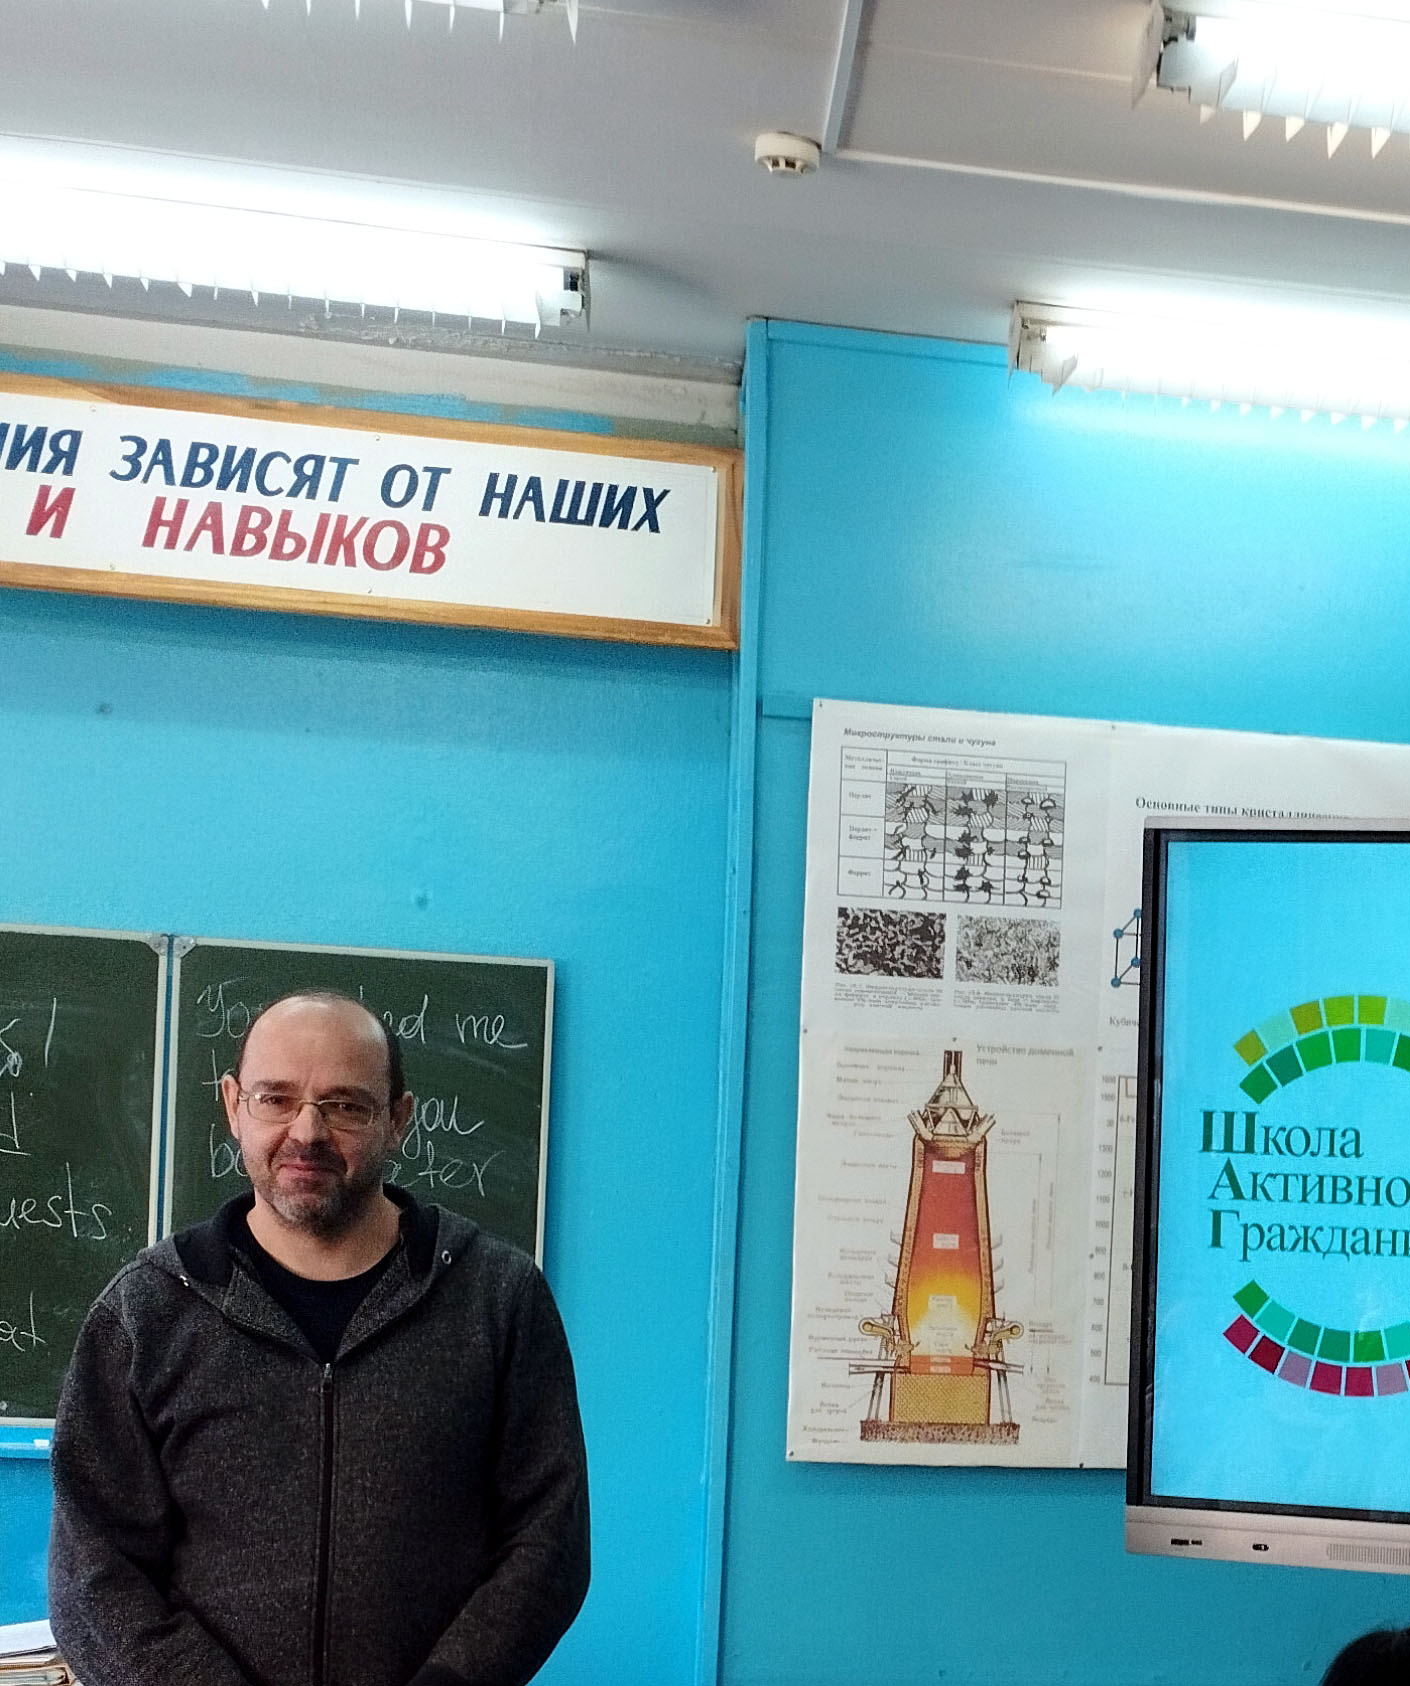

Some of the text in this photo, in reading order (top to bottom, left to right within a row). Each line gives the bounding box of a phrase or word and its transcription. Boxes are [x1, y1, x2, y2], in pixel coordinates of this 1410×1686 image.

[110, 435, 358, 501] ЗАВИСЯТ
[380, 463, 450, 512] ОТ
[480, 472, 671, 532] НАШИХ
[26, 484, 450, 575] И НАВЫКОВ
[455, 1012, 528, 1049] me
[1198, 1109, 1364, 1158] Школа
